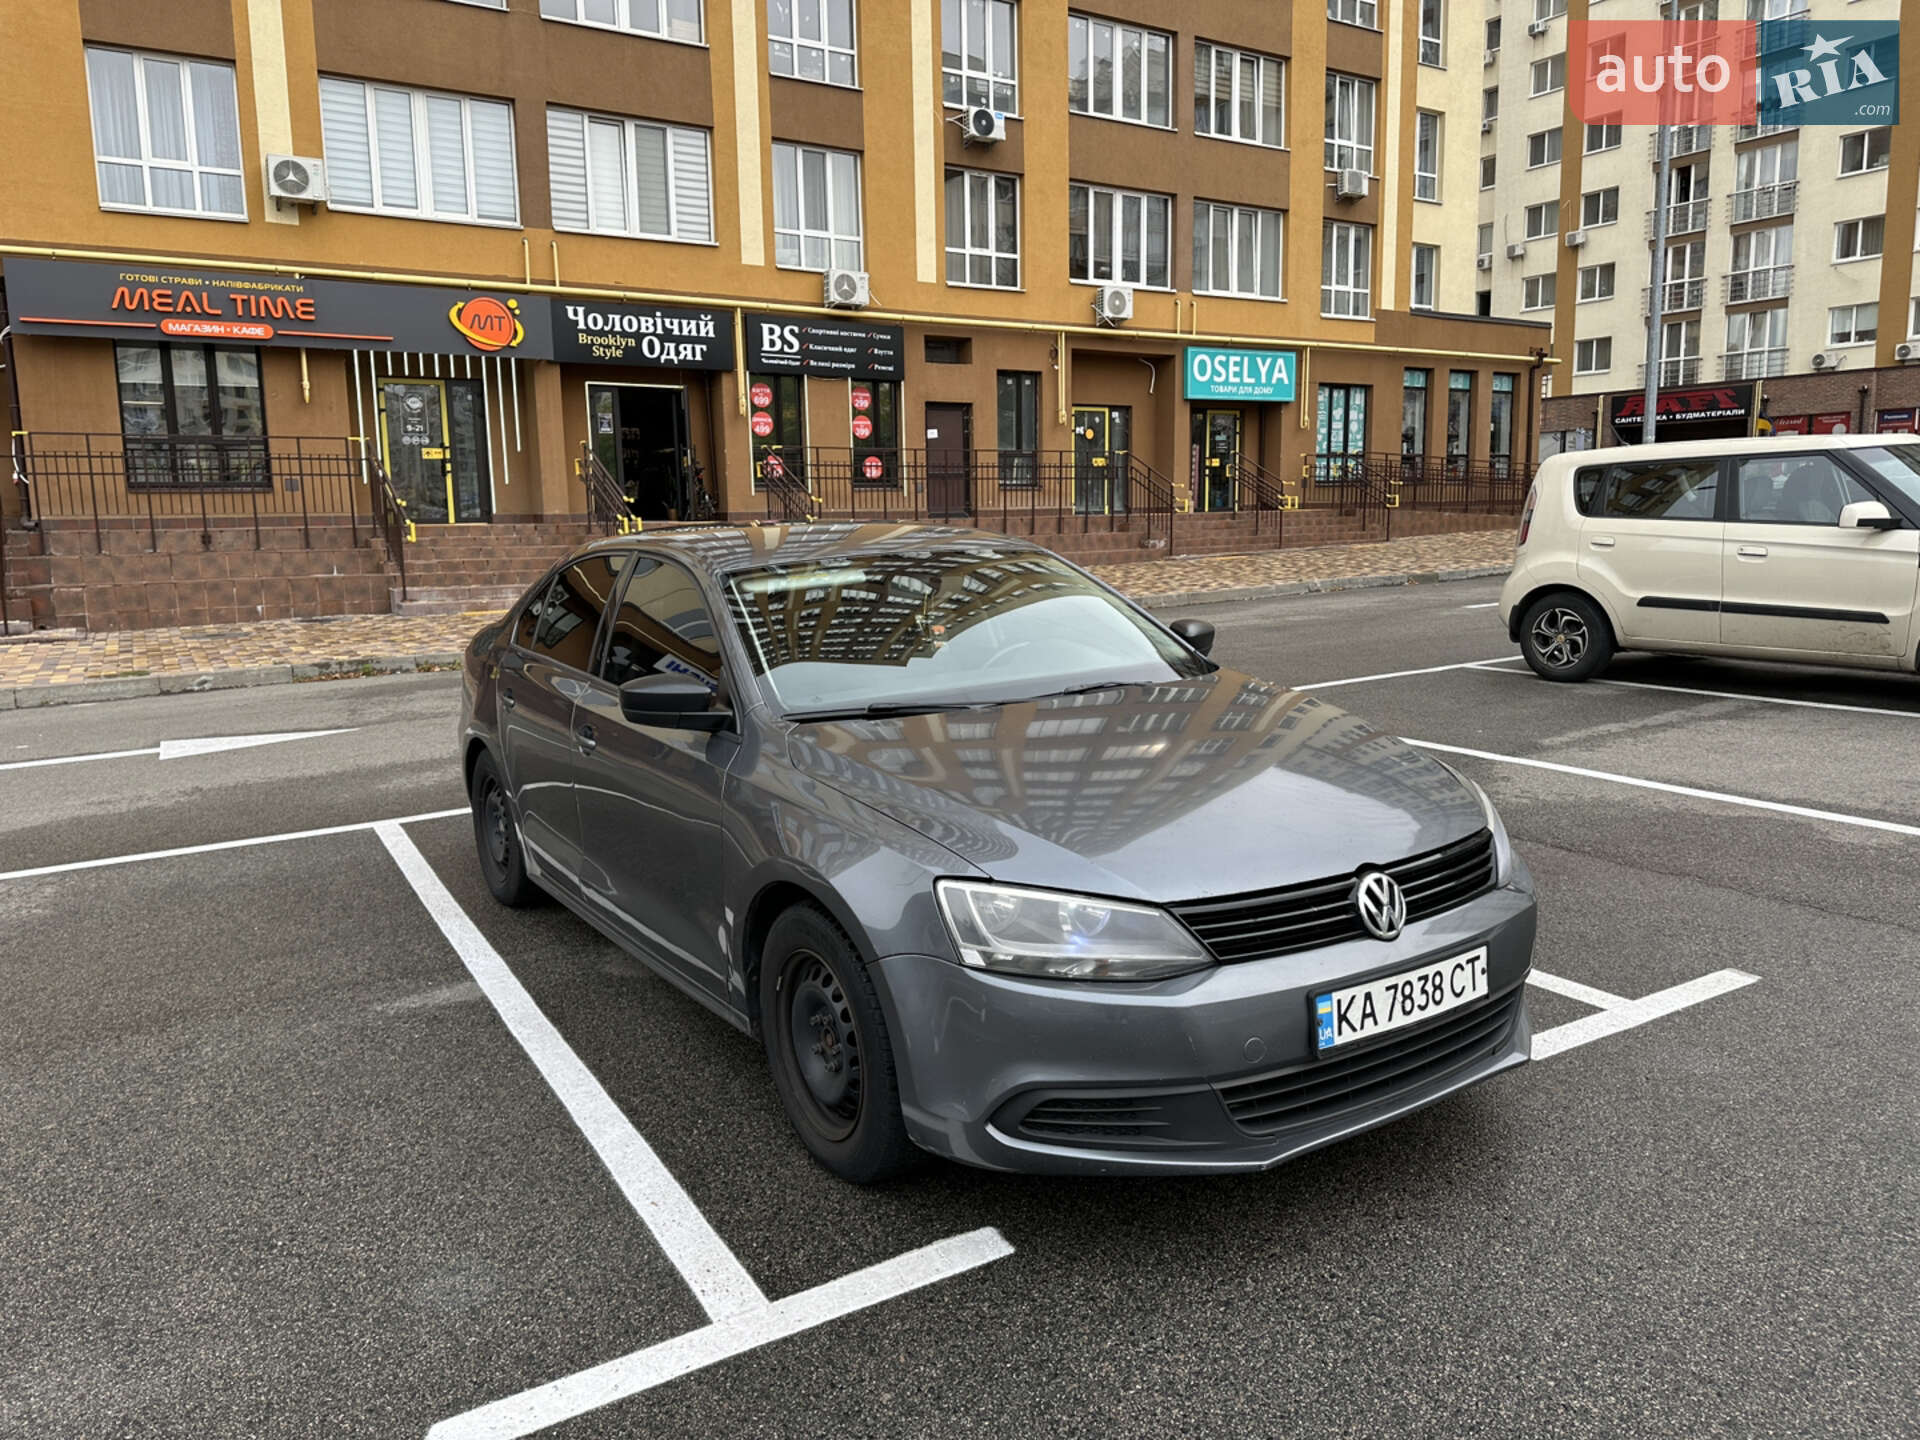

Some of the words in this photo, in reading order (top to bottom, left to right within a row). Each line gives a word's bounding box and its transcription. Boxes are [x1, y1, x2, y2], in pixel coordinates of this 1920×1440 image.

[119, 273, 158, 283] ГОТОВІ
[161, 275, 203, 286] СТРАВИ
[212, 279, 304, 293] НАПІВФАБРИКАТИ
[111, 286, 222, 315] MEAL
[229, 293, 316, 320] TIME
[168, 322, 225, 334] МАГАЗИН
[232, 326, 265, 336] КАФЕ
[565, 305, 716, 338] Чоловічий
[578, 333, 636, 349] Brooklyn
[760, 322, 801, 353] BS
[592, 345, 624, 360] Style
[641, 335, 708, 364] Одяг
[1192, 353, 1289, 384] OSELYA
[1210, 385, 1237, 393] ТОВАРИ
[1238, 386, 1252, 395] ДЛЯ
[1253, 386, 1274, 395] ДОМУ
[1615, 413, 1668, 424] САНТЕКА
[1675, 409, 1745, 420] БУДМАТЕРІАЛИ
[1336, 991, 1378, 1037] KA
[1385, 970, 1444, 1023] 7838
[1450, 955, 1481, 998] CT
[1318, 1027, 1333, 1041] UA
